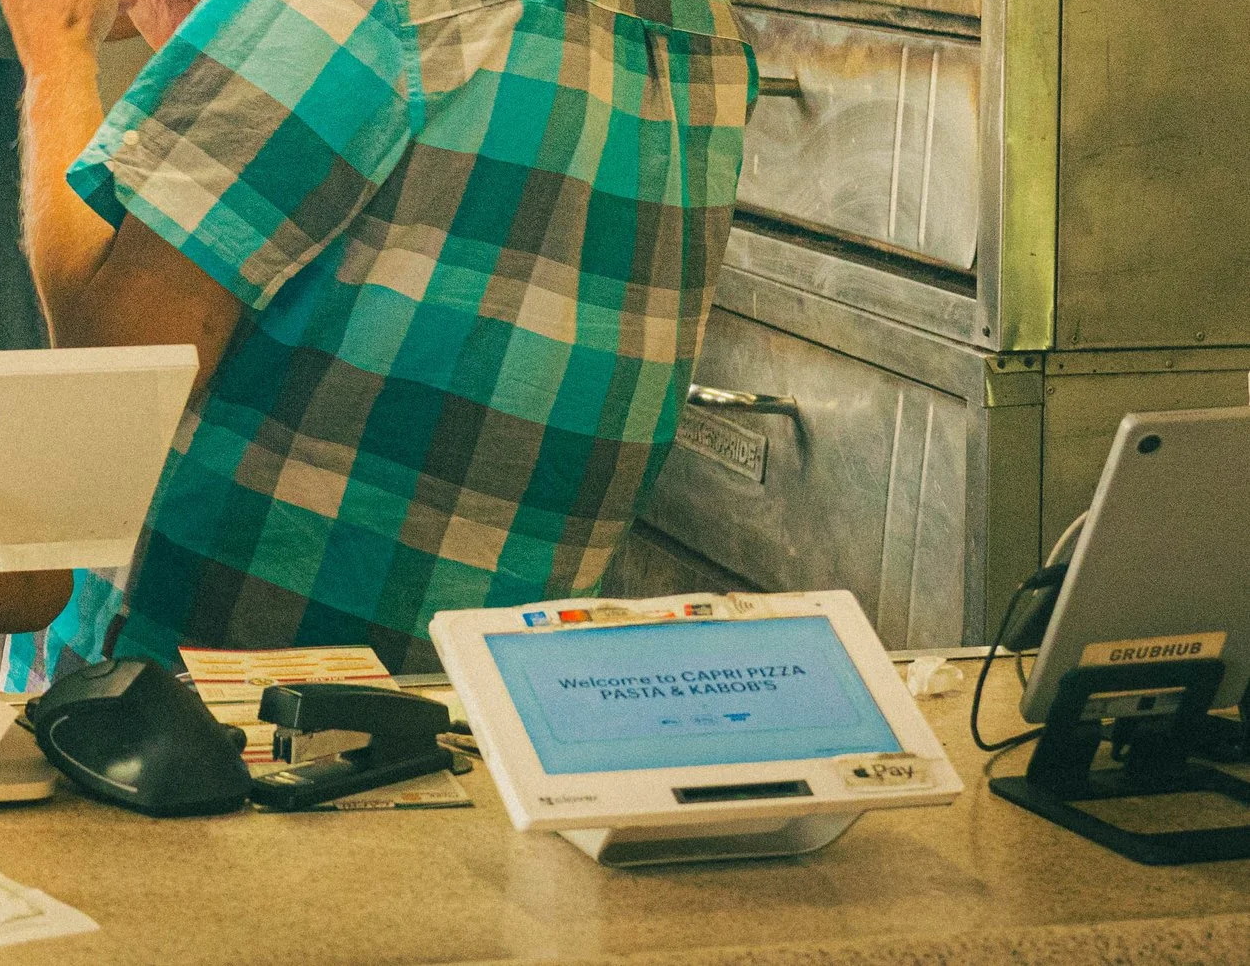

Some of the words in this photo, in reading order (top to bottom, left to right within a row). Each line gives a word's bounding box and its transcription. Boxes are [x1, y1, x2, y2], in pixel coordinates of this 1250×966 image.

[1110, 641, 1202, 662] GRUBHUB
[558, 676, 651, 690] Welcome
[656, 673, 676, 684] to
[681, 668, 741, 683] CAPRI
[746, 664, 806, 679] PIZZA
[601, 687, 666, 701] PASTA
[672, 685, 685, 697] &
[690, 679, 778, 695] KABOB'S
[871, 763, 913, 782] Pay
